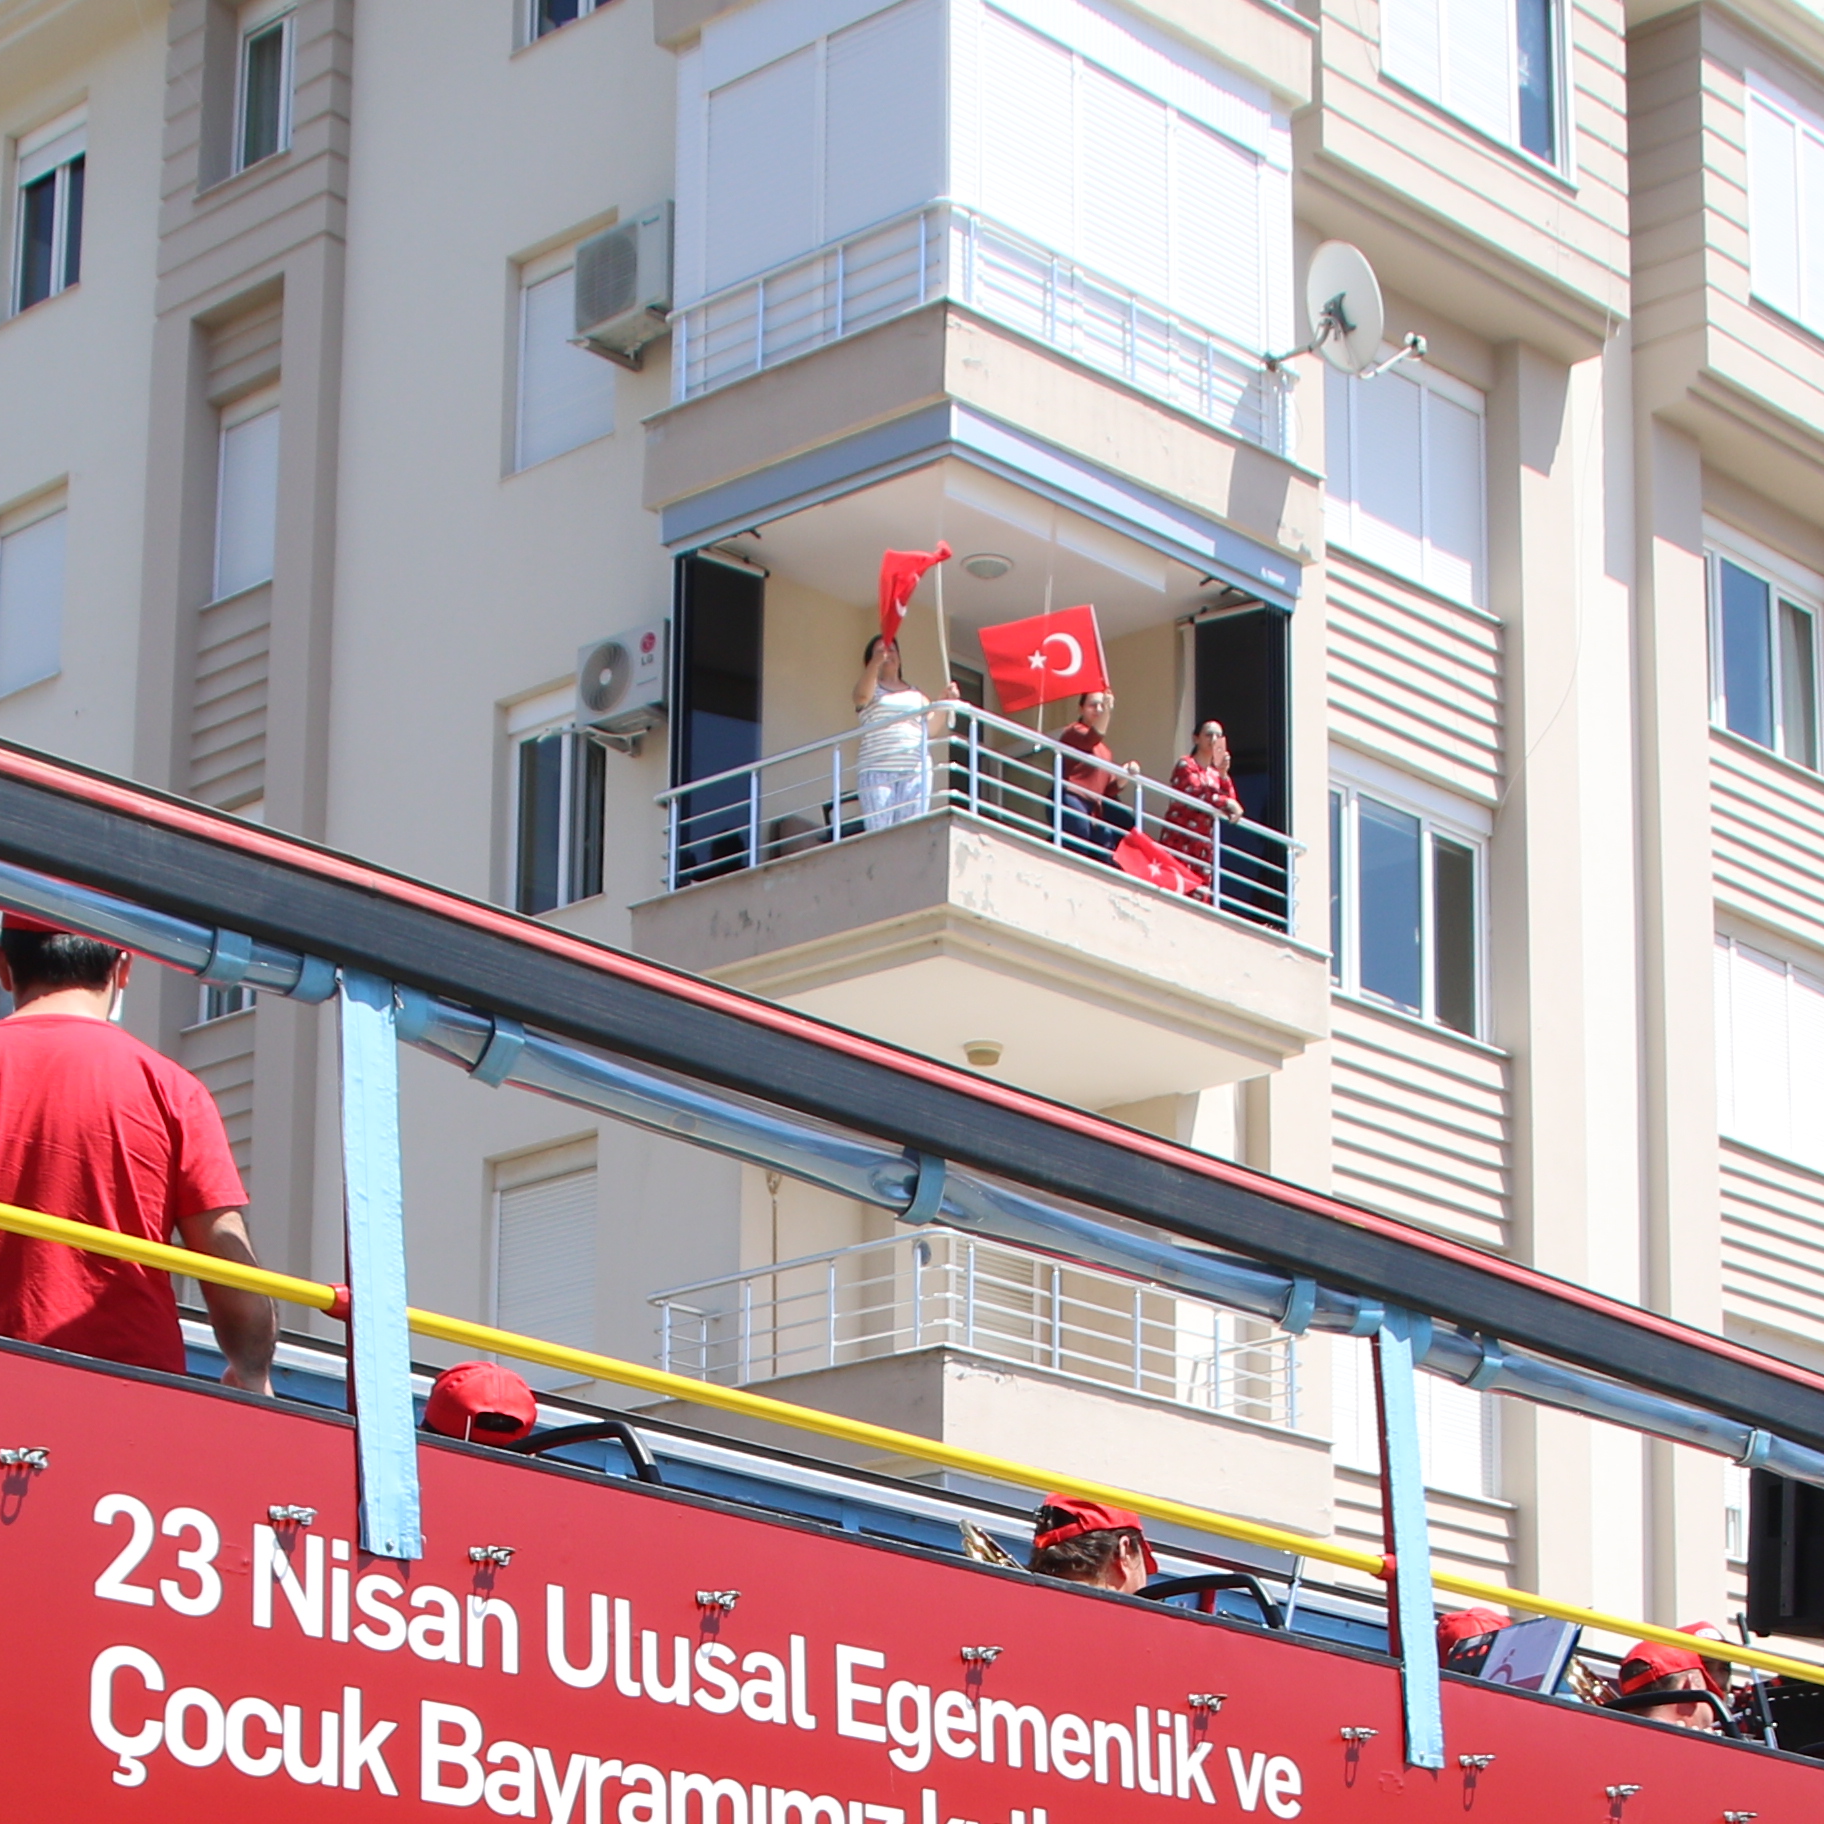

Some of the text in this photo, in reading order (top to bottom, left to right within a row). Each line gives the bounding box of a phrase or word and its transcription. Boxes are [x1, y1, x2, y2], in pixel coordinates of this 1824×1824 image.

[89, 1644, 399, 1797] Çocuk
[93, 1493, 1303, 1820] 23 Nisan Ulusal Egemenlik ve
